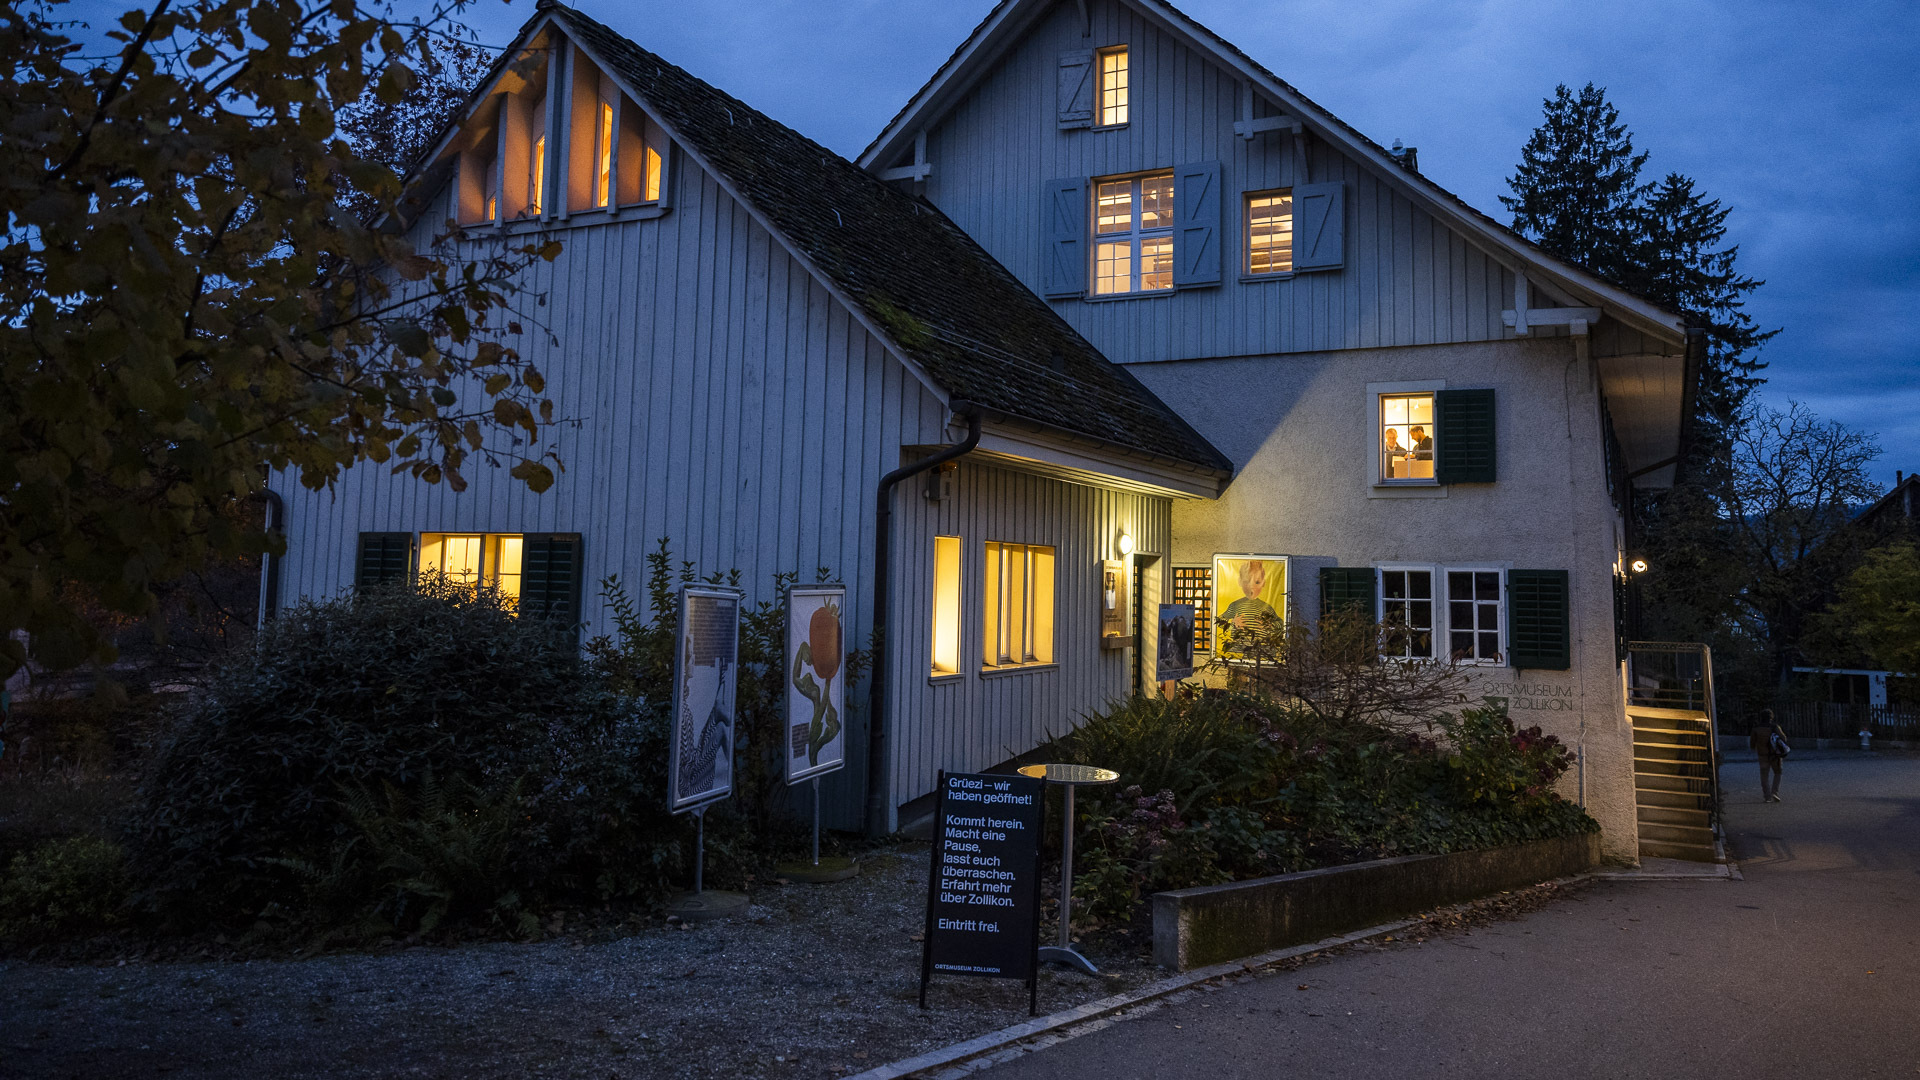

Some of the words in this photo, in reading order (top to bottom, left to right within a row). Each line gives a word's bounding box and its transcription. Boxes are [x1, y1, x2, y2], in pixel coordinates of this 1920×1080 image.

[1482, 682, 1572, 697] ORTSMUSEUM
[1512, 697, 1573, 711] ZOLLIKON
[949, 777, 983, 789] Grüezi
[994, 781, 1010, 791] wir
[948, 790, 982, 801] haben
[984, 793, 1032, 805] geöffnet!
[946, 815, 986, 826] Kommt
[988, 818, 1024, 829] herein.
[945, 828, 980, 839] Macht
[982, 831, 1005, 841] eine
[944, 840, 981, 853] Pause,
[943, 853, 971, 864] lasst
[972, 856, 1000, 866] euch
[942, 866, 1016, 880] überraschen.
[941, 879, 980, 891] Erfahrt
[982, 884, 1011, 893] mehr
[940, 892, 966, 903] über
[968, 894, 1015, 906] Zollikon.
[938, 919, 976, 931] Eintritt
[978, 921, 999, 933] frei.
[934, 963, 972, 971] ORTSMUSEUM
